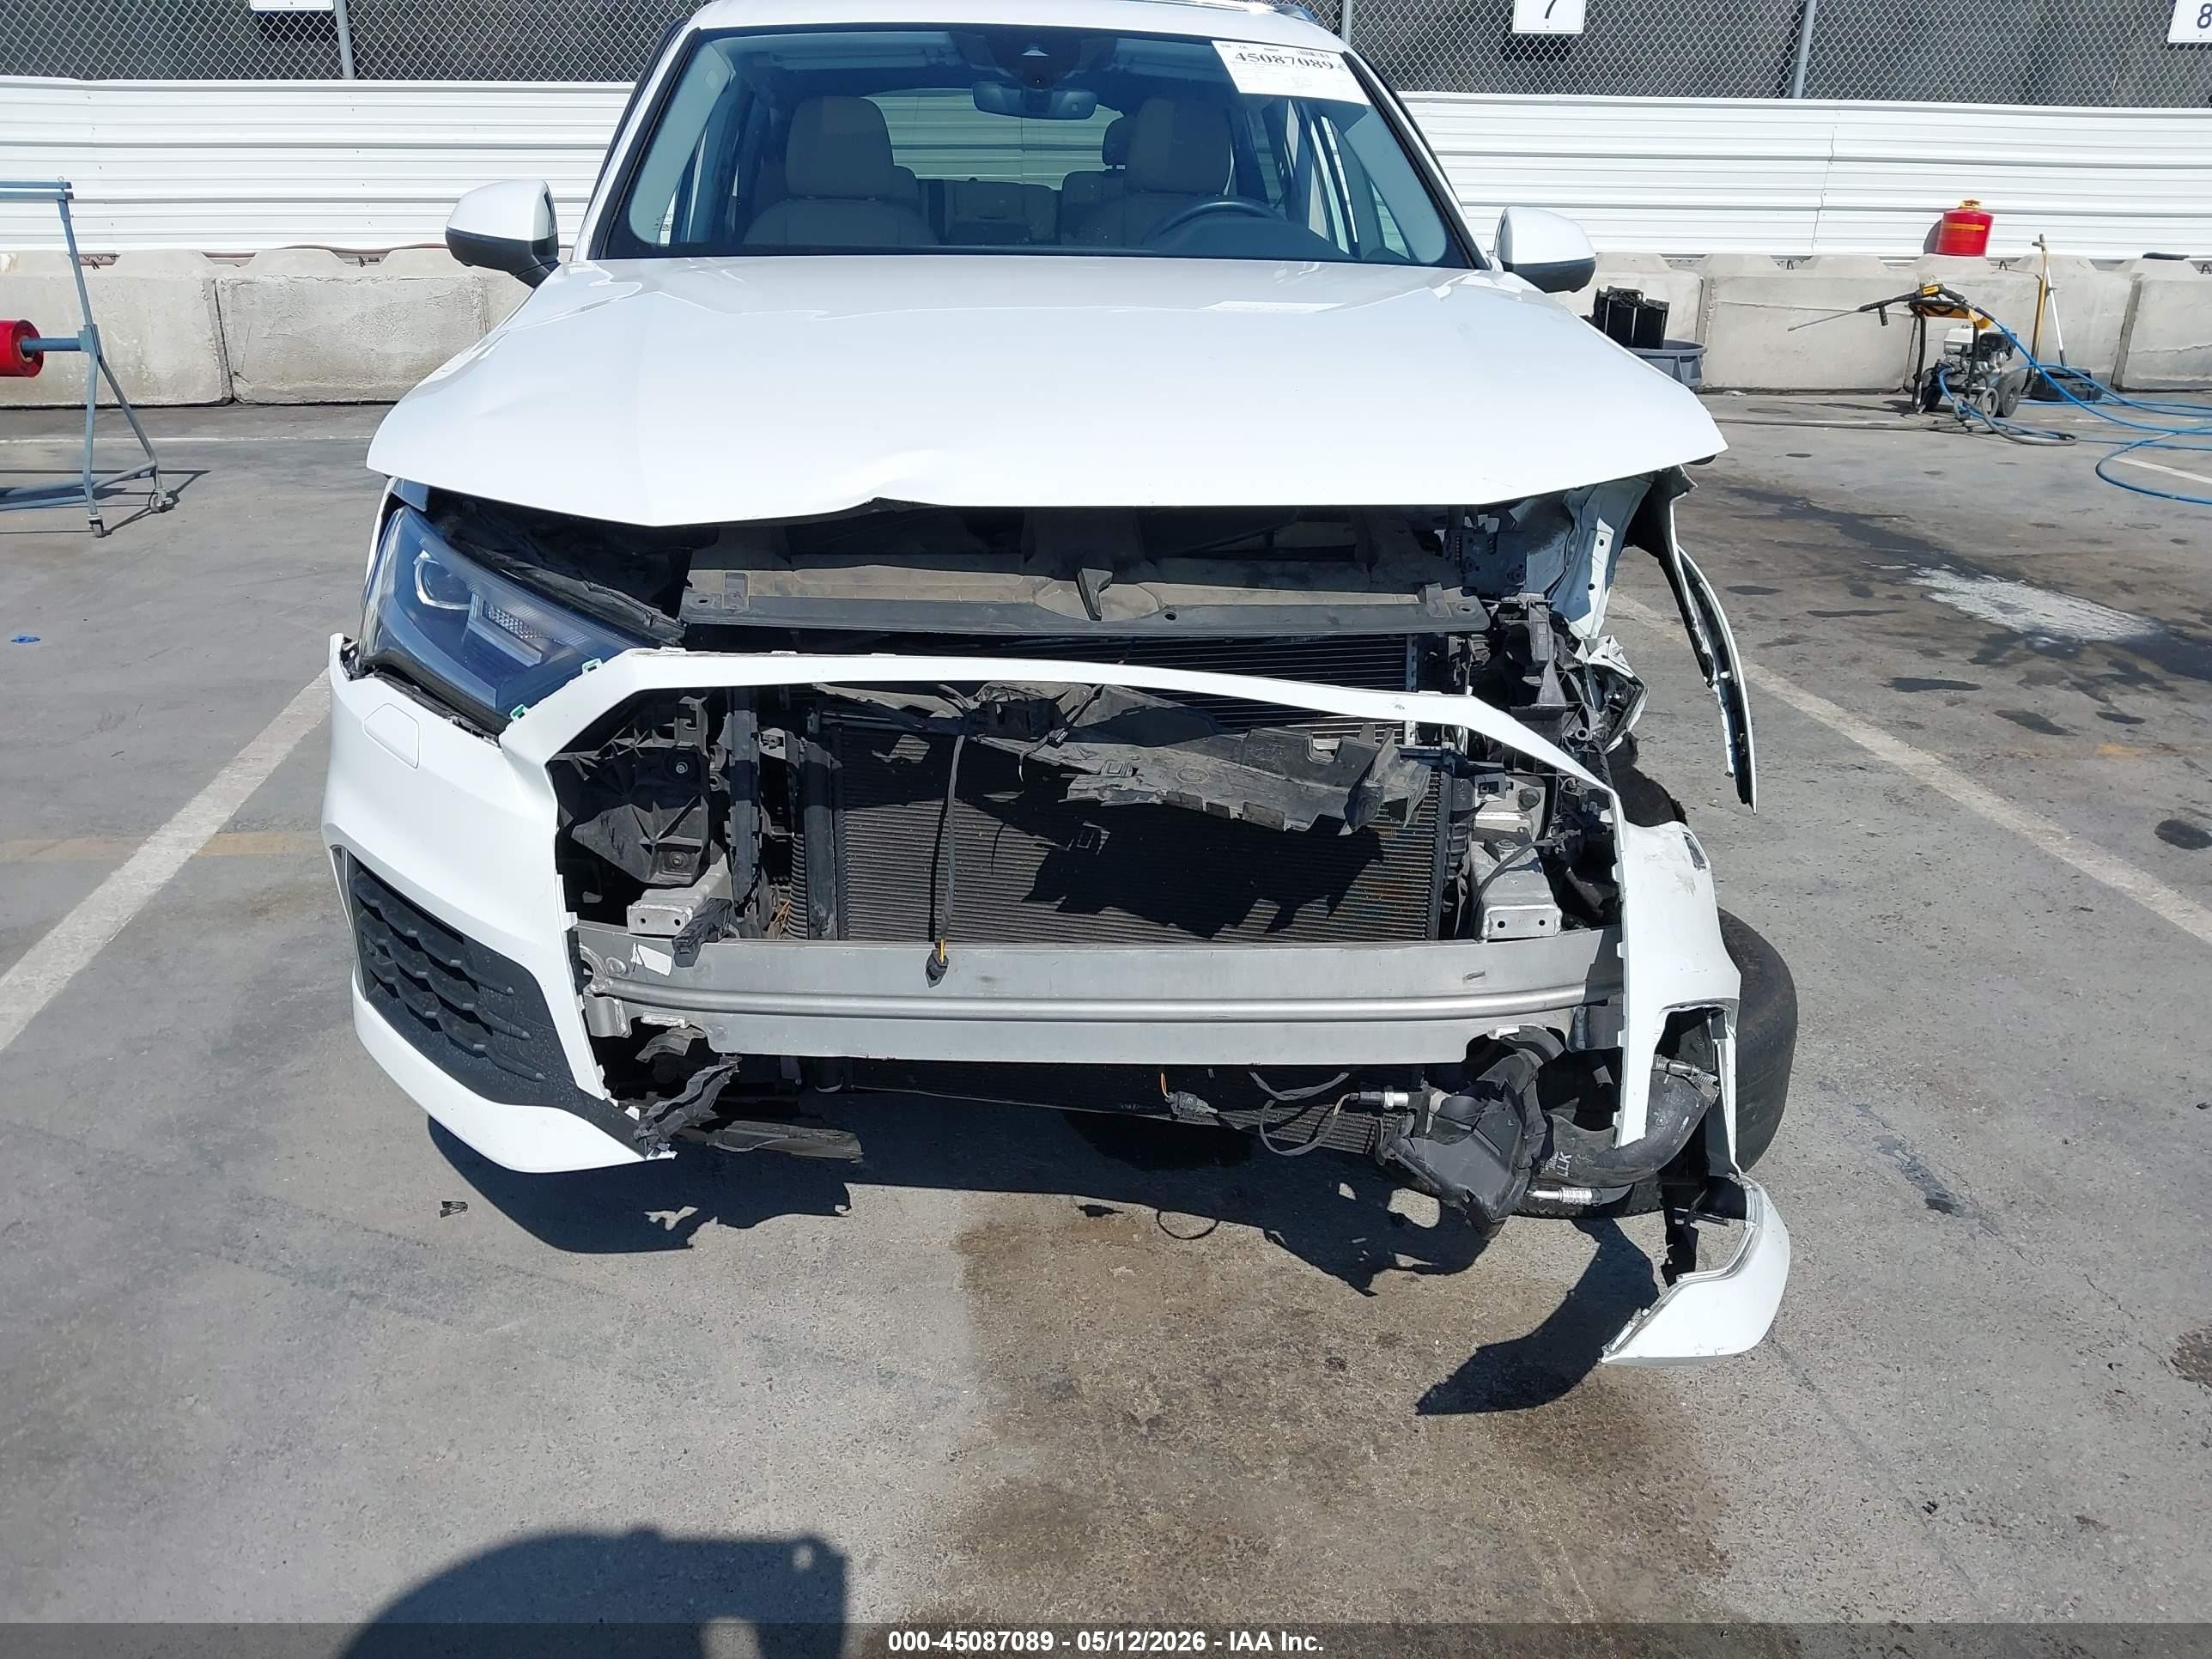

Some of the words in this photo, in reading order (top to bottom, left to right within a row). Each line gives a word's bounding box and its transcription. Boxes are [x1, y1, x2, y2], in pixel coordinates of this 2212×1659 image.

[2197, 3, 2212, 29] 8
[1235, 52, 1334, 70] 45087089
[1556, 1151, 1572, 1177] LLK
